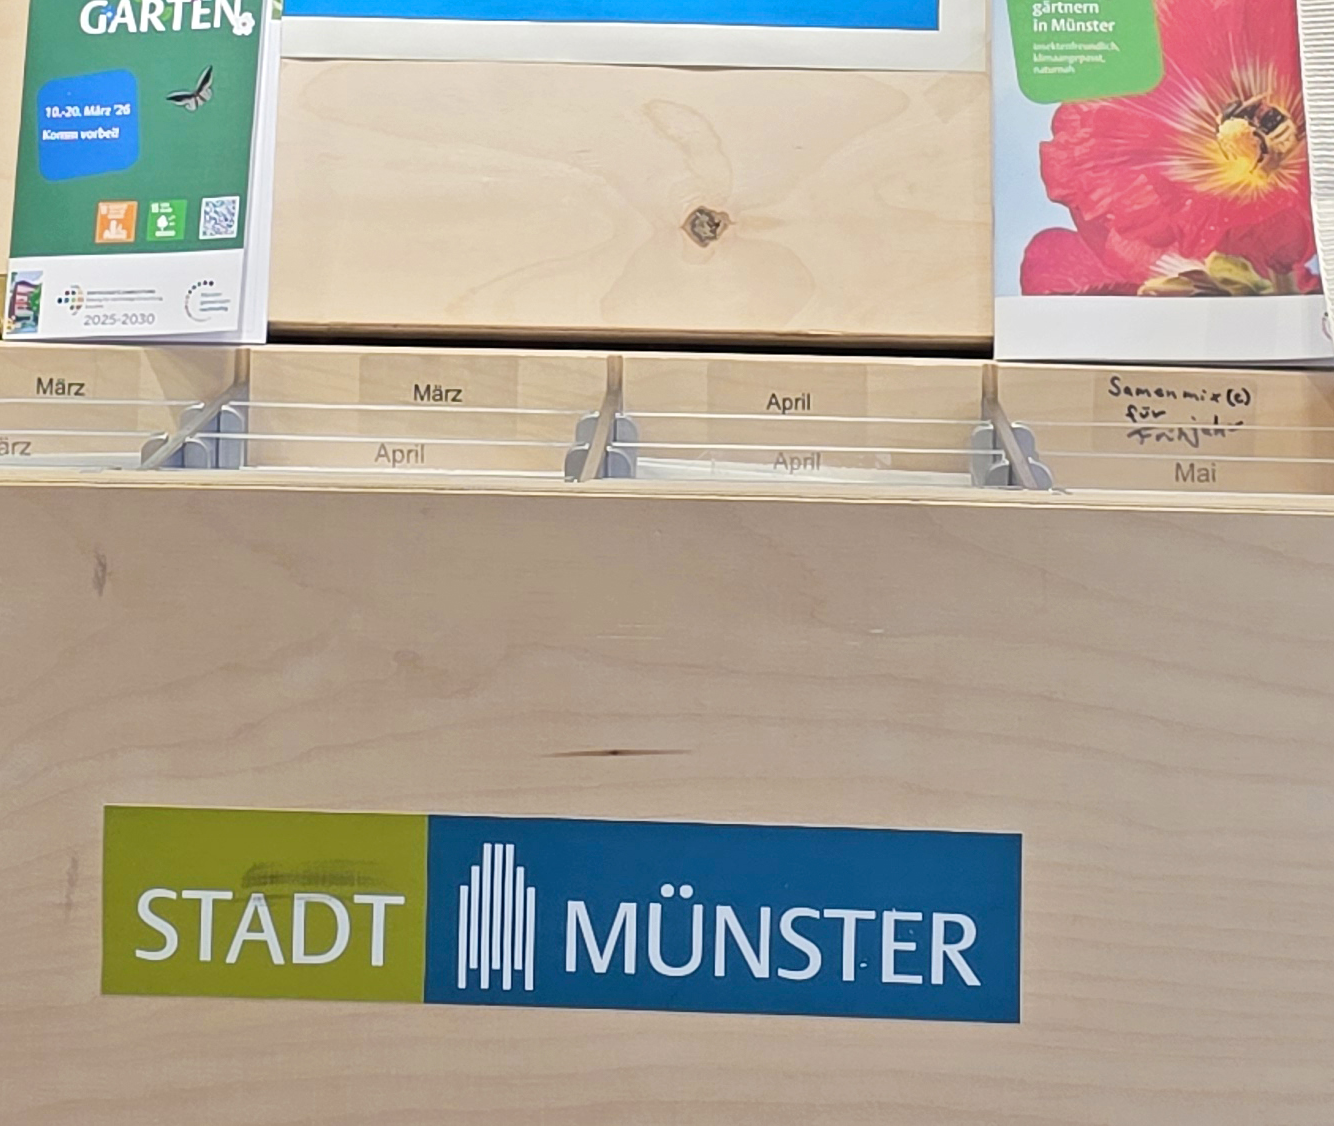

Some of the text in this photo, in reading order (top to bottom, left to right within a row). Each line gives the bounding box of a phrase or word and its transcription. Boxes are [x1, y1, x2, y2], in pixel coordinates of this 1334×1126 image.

[1032, 0, 1100, 17] gärtnern
[1033, 18, 1116, 32] in Münster
[83, 314, 156, 326] 2025-2030
[36, 377, 85, 396] März
[413, 383, 463, 403] März
[766, 392, 811, 415] April
[1125, 404, 1167, 423] für
[374, 443, 425, 468] April
[773, 451, 821, 475] April
[1174, 462, 1217, 483] Mai
[135, 883, 982, 987] STADT MÜNSTER
